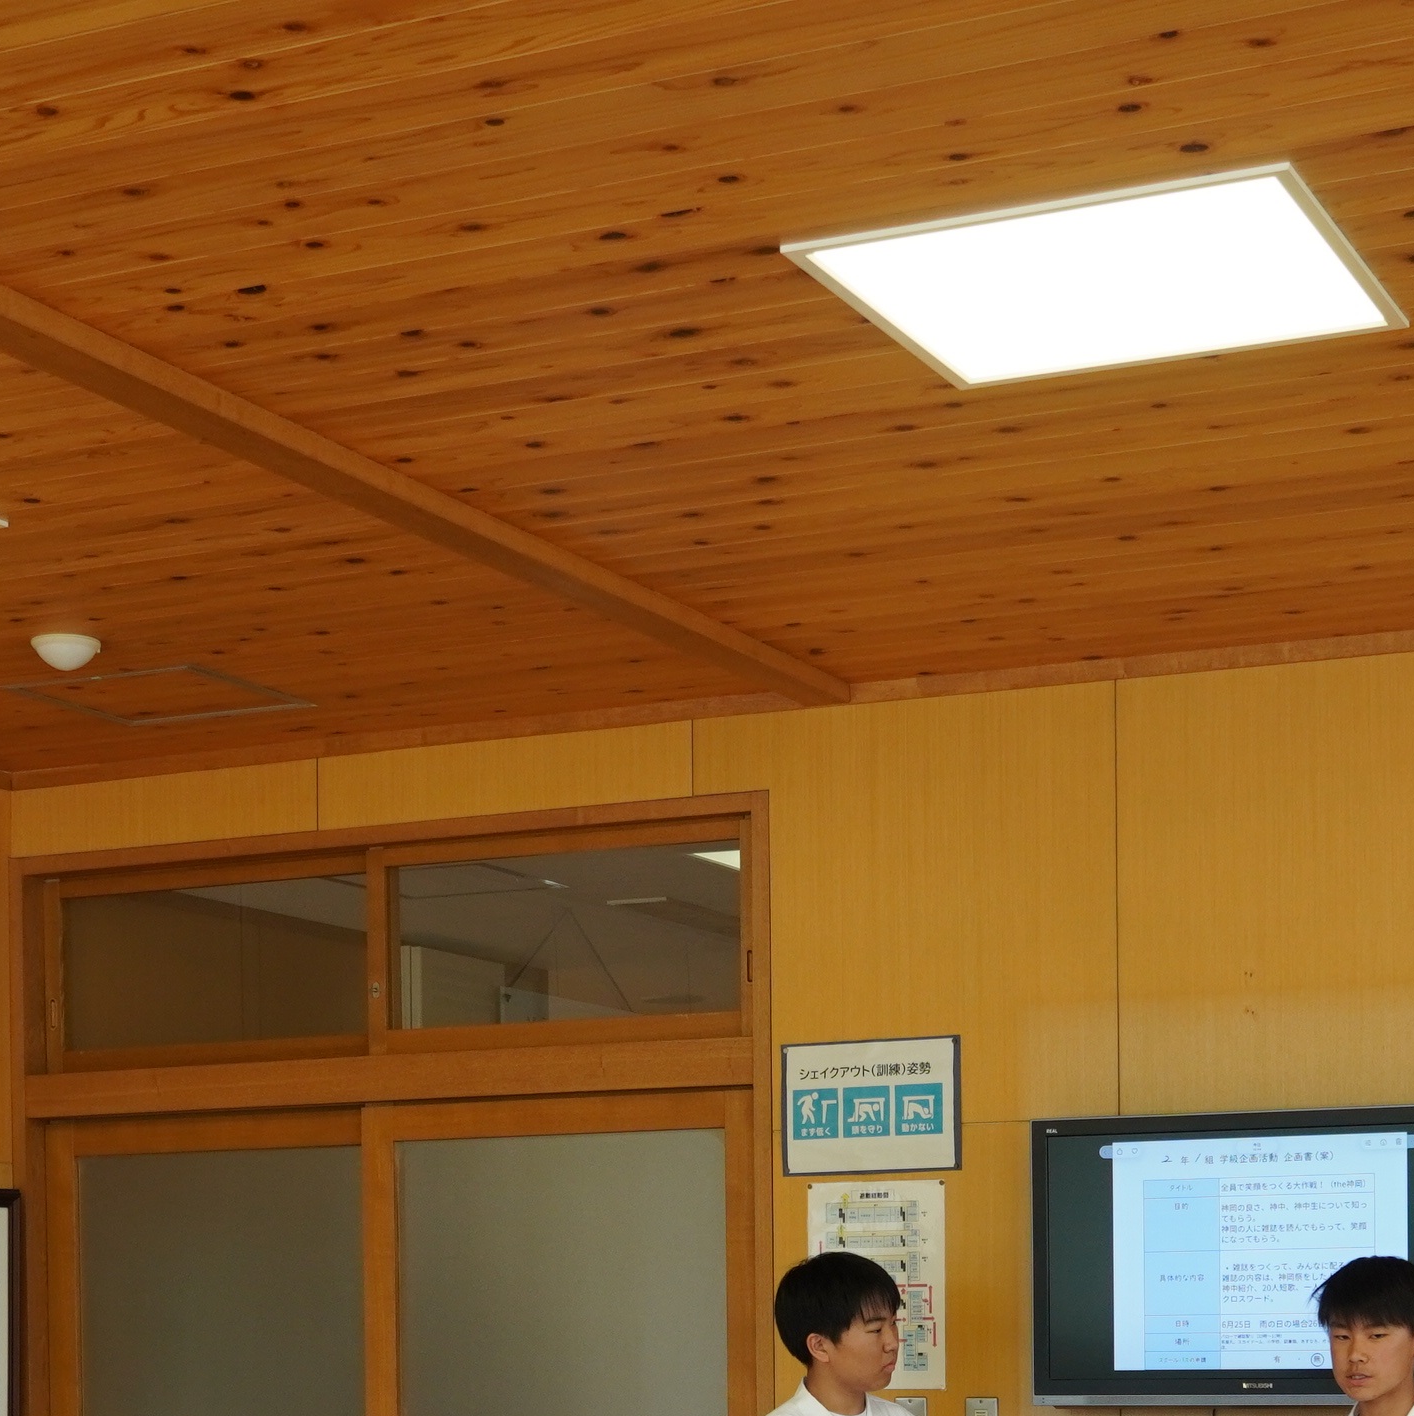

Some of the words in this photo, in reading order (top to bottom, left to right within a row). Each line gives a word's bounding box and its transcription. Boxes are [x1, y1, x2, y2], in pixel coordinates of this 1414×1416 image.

[799, 1062, 931, 1080] シェイクアウト(訓練)姿勢
[800, 1127, 830, 1137] まず低く
[851, 1125, 883, 1135] 頭を守り
[901, 1123, 934, 1133] 動かない
[1180, 1156, 1189, 1164] 年
[1205, 1155, 1214, 1164] 組
[1220, 1153, 1278, 1164] 学級企画活動
[1169, 1184, 1193, 1192] タイトル
[1174, 1202, 1189, 1211] 目的
[1222, 1215, 1256, 1223] てもらう。
[1221, 1234, 1281, 1244] になってもらう。
[1159, 1273, 1205, 1283] 具体的な内容
[1222, 1295, 1274, 1303] クロスワード。
[1175, 1320, 1190, 1328] 日時
[1222, 1320, 1251, 1329] 6月25日
[1273, 1355, 1282, 1364] 有
